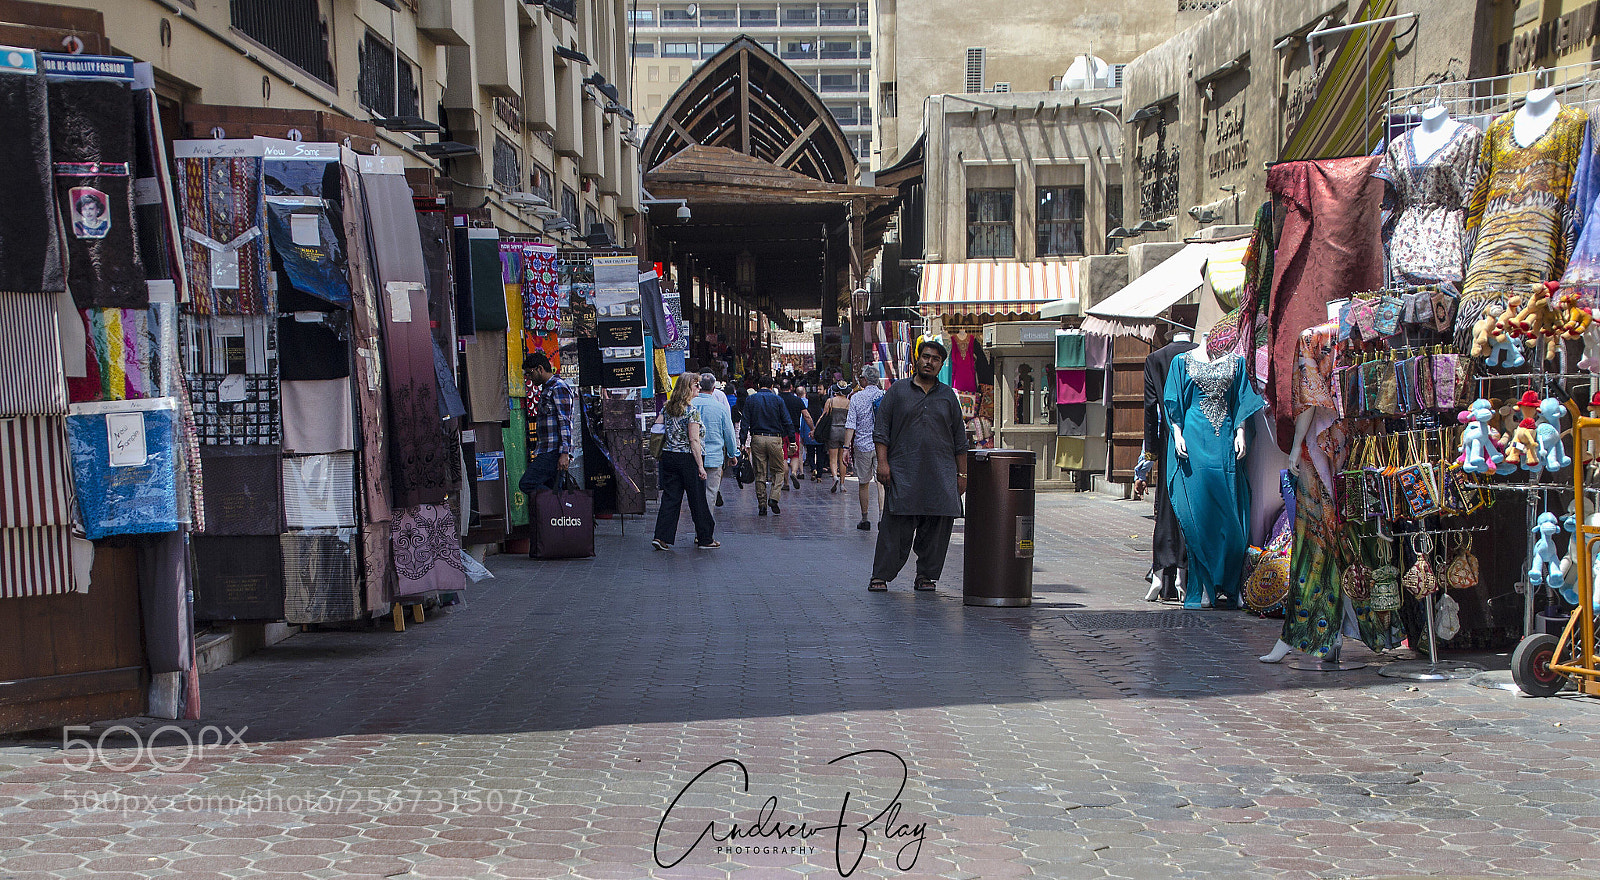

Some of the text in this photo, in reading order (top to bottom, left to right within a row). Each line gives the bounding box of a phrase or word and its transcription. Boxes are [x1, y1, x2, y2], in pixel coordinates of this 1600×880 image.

[57, 60, 96, 72] HI-QUALITY
[97, 62, 126, 74] FASHION
[550, 516, 582, 527] adidas
